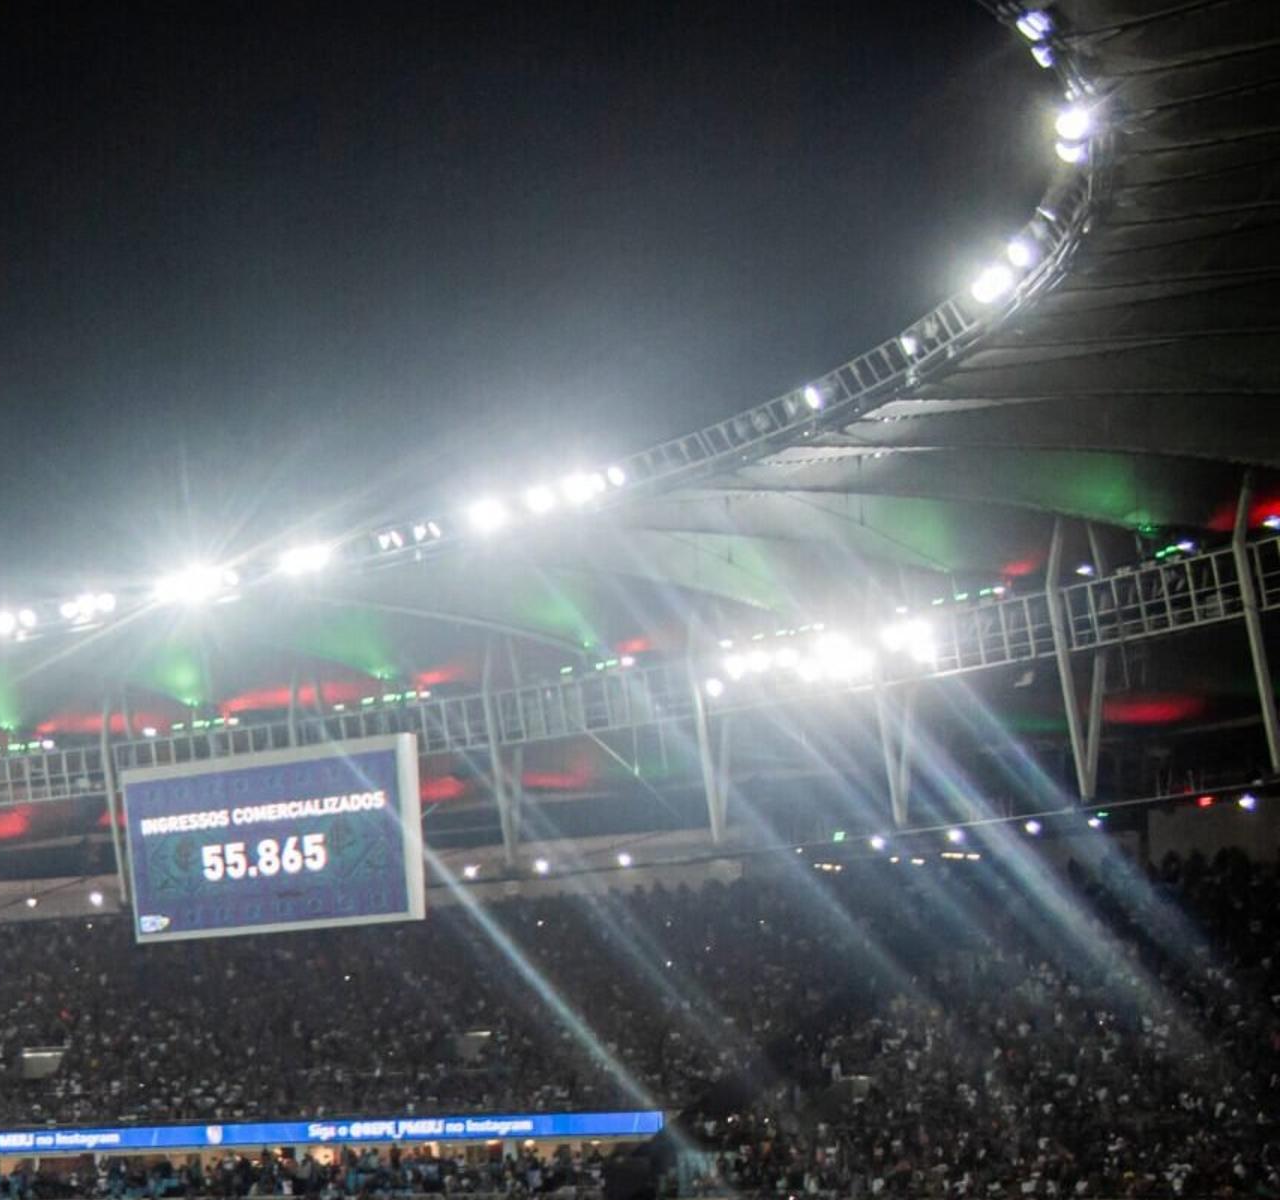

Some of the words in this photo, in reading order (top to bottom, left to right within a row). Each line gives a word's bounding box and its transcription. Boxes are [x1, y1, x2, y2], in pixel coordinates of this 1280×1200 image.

[141, 808, 229, 836] INGRESSOS
[232, 790, 386, 824] COMERCIALIZADOS
[202, 833, 327, 882] 55.865
